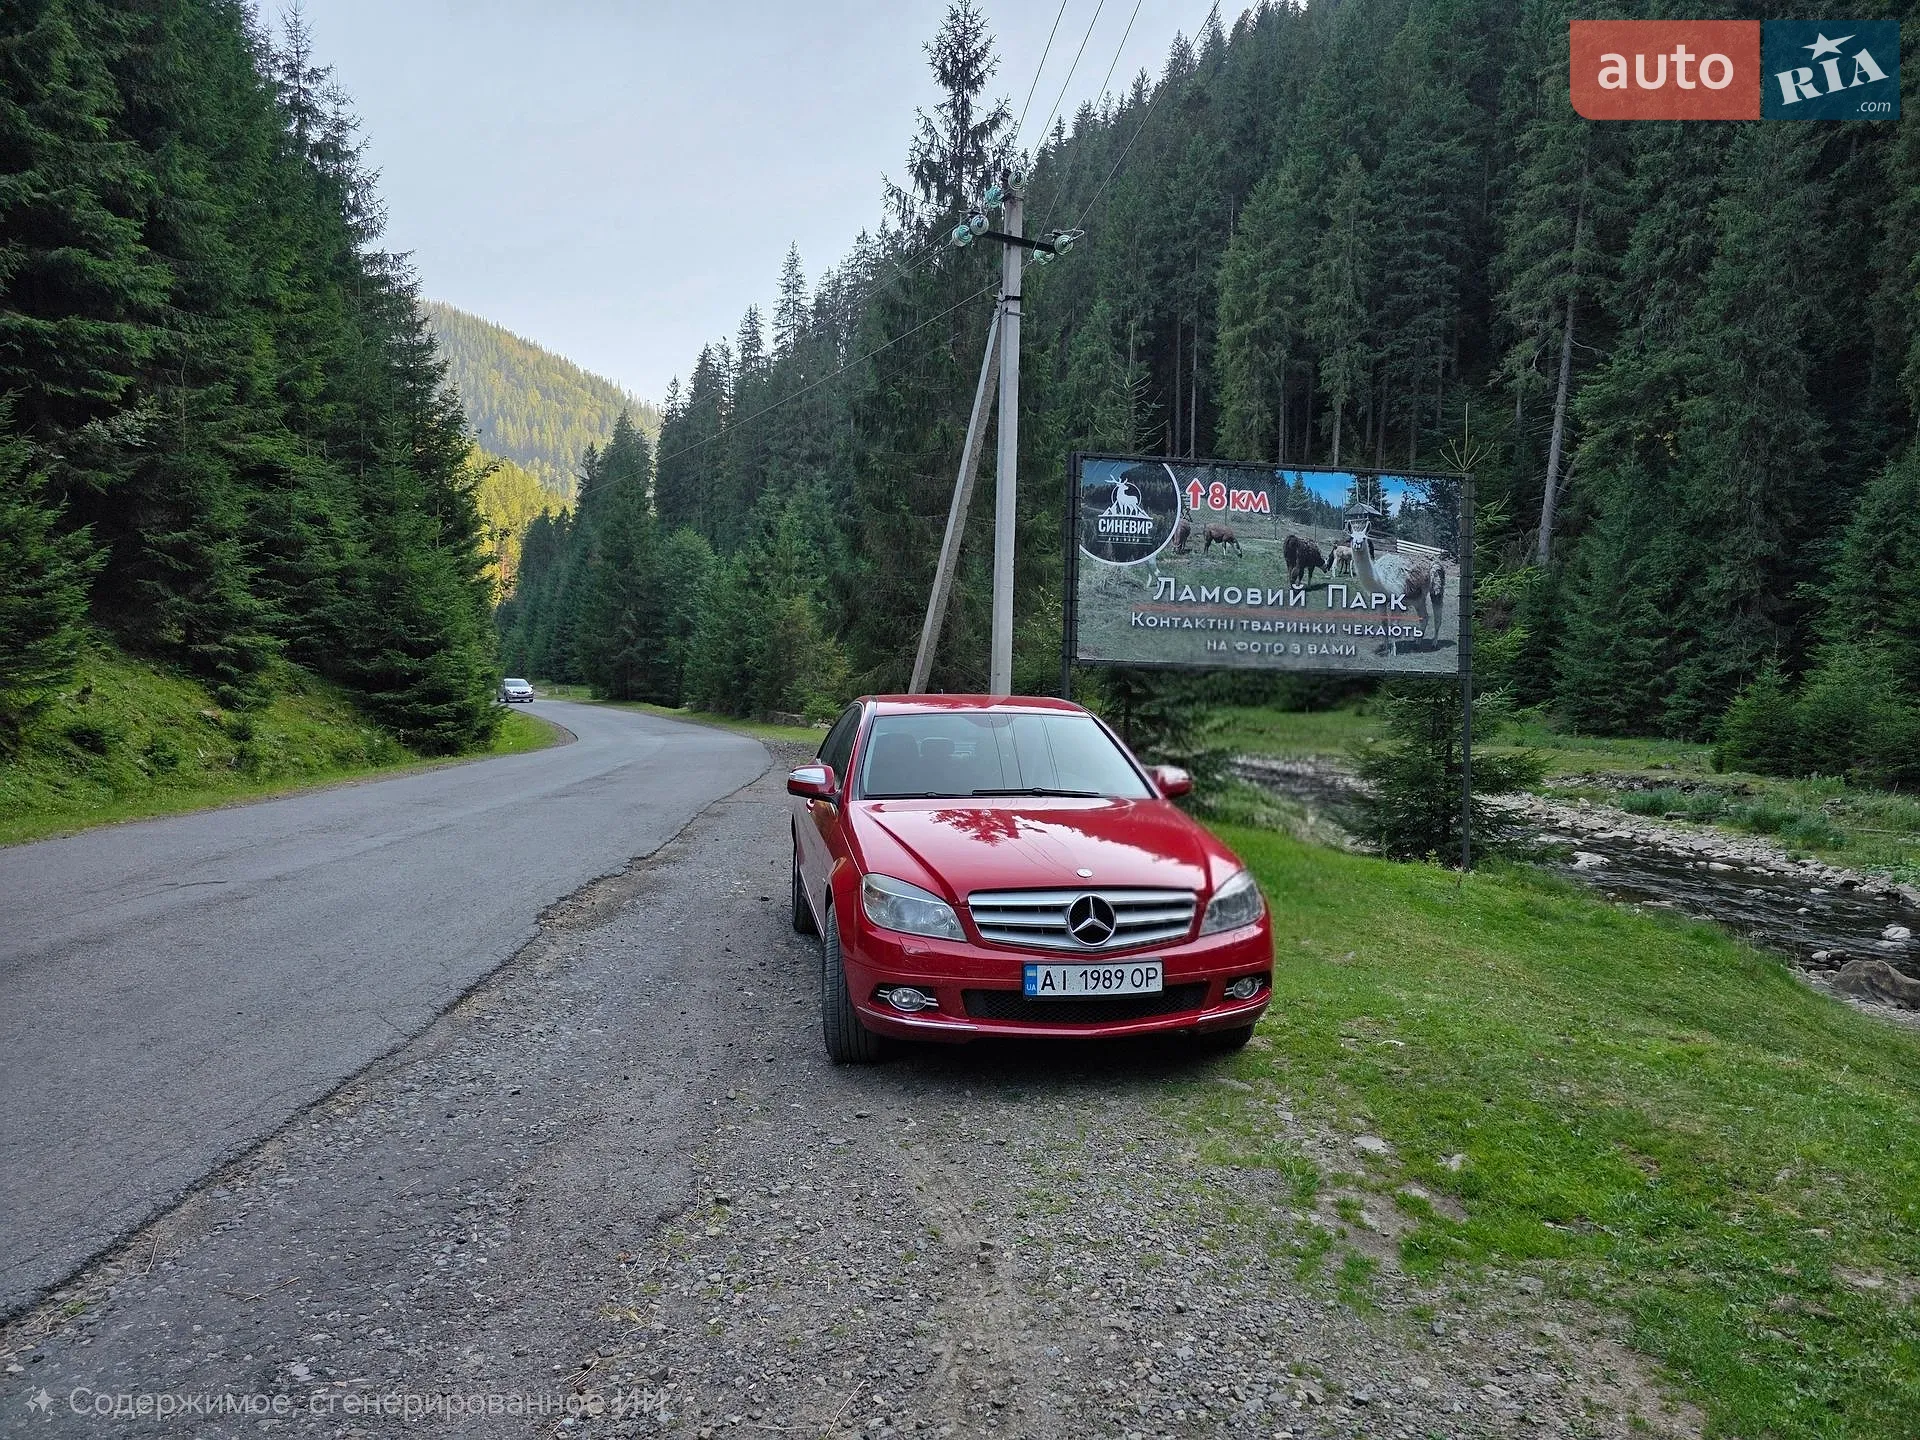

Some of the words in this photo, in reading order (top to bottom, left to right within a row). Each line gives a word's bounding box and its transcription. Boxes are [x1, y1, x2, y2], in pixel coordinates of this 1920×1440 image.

[1098, 518, 1153, 535] СИНЕВИР
[1041, 970, 1067, 991] AI
[1079, 969, 1125, 990] 1989
[1130, 967, 1158, 988] OP
[1026, 984, 1037, 992] UA
